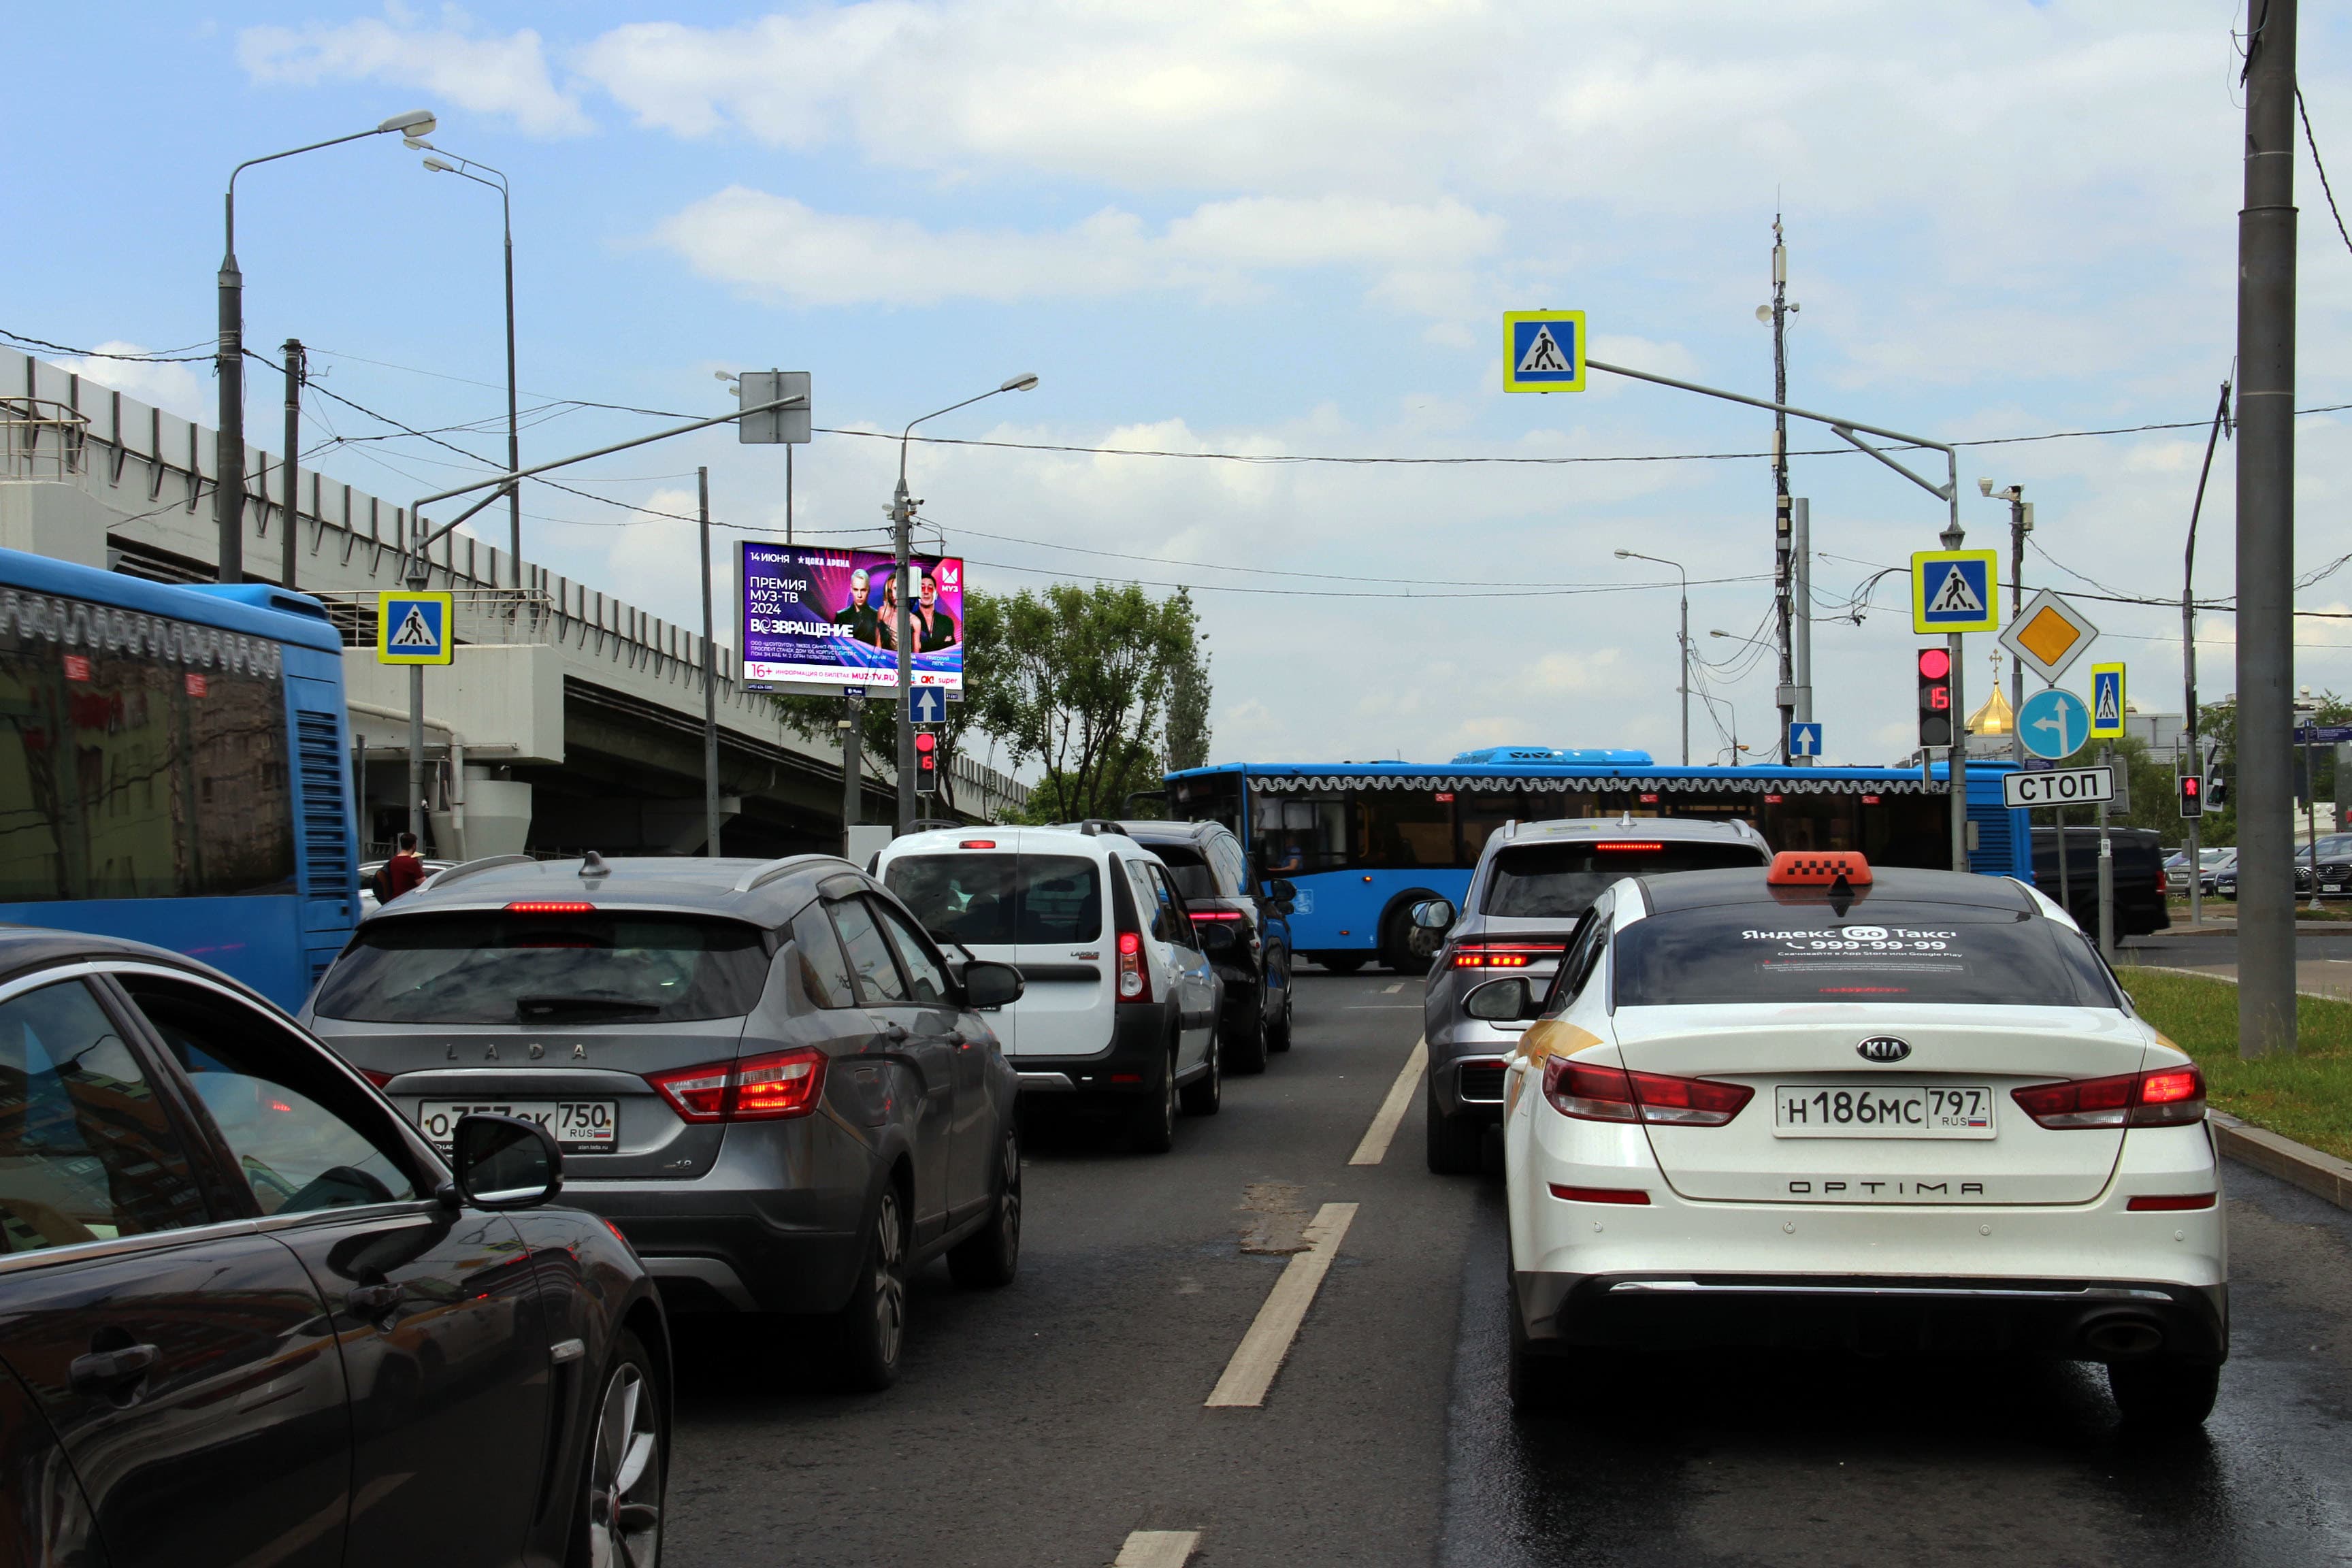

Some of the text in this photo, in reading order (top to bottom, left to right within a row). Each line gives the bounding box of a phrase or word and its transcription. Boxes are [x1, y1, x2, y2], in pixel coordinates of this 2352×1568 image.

[750, 552, 789, 563] 14 ИЮНЯ
[805, 557, 850, 568] ЦСКА АРЕНА
[750, 576, 806, 591] ПРЕМИЯ
[750, 589, 798, 603] МУЗ-ТВ
[751, 602, 781, 615] 2024
[750, 617, 853, 638] ВОЗВРАЩЕНИЕ
[751, 664, 772, 678] 16+
[776, 669, 817, 677] ИНФОРМАЦИЯ
[852, 672, 894, 681] MUZ-TV.RU
[2019, 774, 2099, 801] СТОП
[1742, 930, 1837, 940] Яндекс
[1810, 941, 1946, 950] 999-99-99
[446, 1043, 588, 1060] LADA
[1865, 1041, 1903, 1057] KIA
[1788, 1090, 1981, 1124] Н186МС 797
[559, 1104, 606, 1128] 750
[1942, 1117, 1967, 1126] RUS
[570, 1128, 593, 1138] RUS
[1789, 1181, 1983, 1195] OPTIMA
